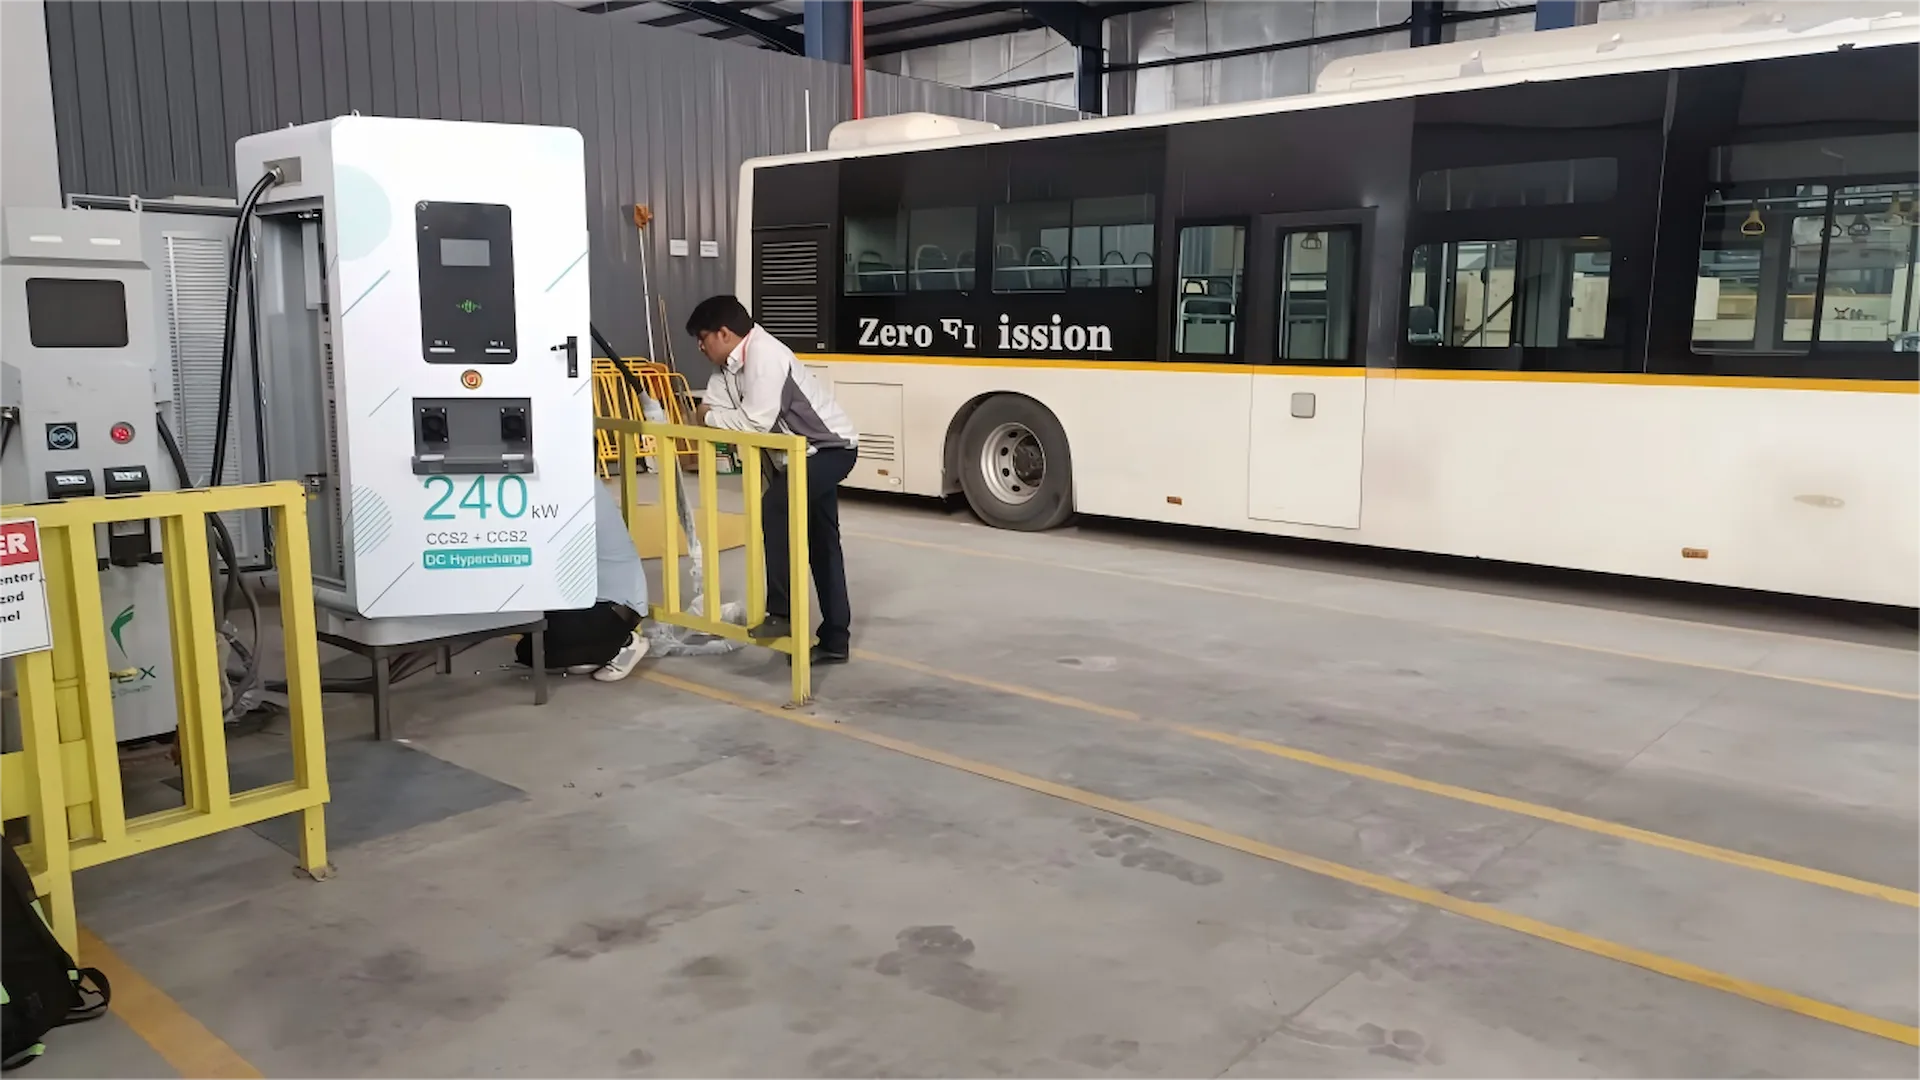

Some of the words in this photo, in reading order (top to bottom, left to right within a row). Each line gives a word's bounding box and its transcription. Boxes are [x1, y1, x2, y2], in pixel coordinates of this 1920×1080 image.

[858, 317, 933, 348] Zero
[940, 313, 1113, 351] Eission
[423, 474, 529, 520] 240
[531, 503, 559, 519] kW
[426, 532, 469, 545] CCS2
[473, 534, 481, 542] +
[486, 530, 528, 543] CCS2
[425, 553, 447, 566] DC
[450, 551, 530, 567] Hypercharge
